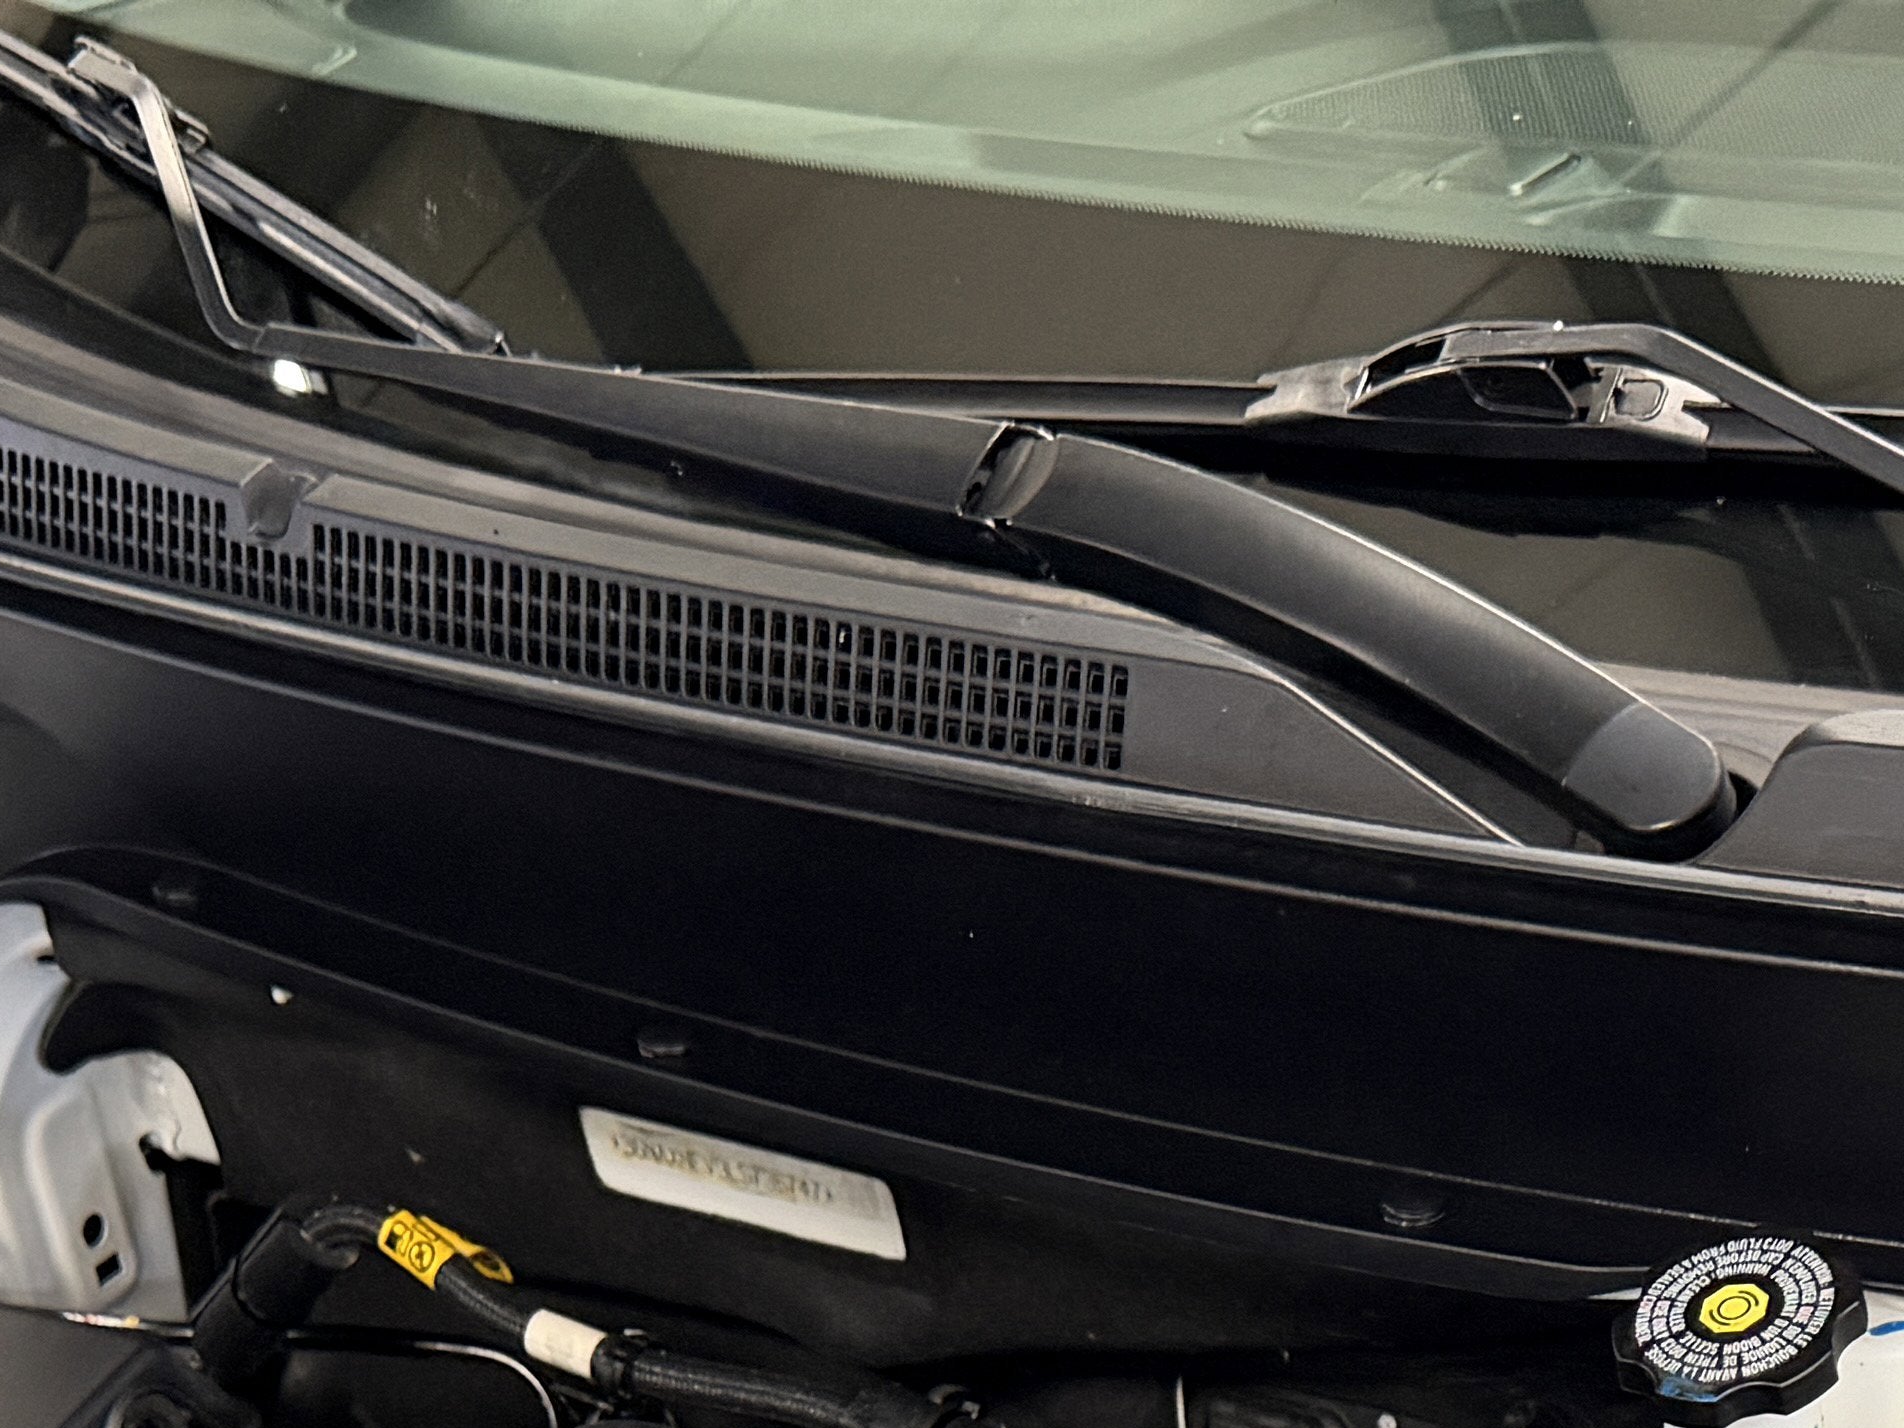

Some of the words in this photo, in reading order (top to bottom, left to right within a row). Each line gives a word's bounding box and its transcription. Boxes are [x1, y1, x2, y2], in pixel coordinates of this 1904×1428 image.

[1687, 1242, 1725, 1264] FROM
[1721, 1335, 1763, 1354] BIDON
[1741, 1336, 1788, 1364] LIQUIDE
[1719, 1354, 1737, 1367] DE
[1741, 1343, 1800, 1378] BOUCHON
[1696, 1367, 1737, 1382] AVANT
